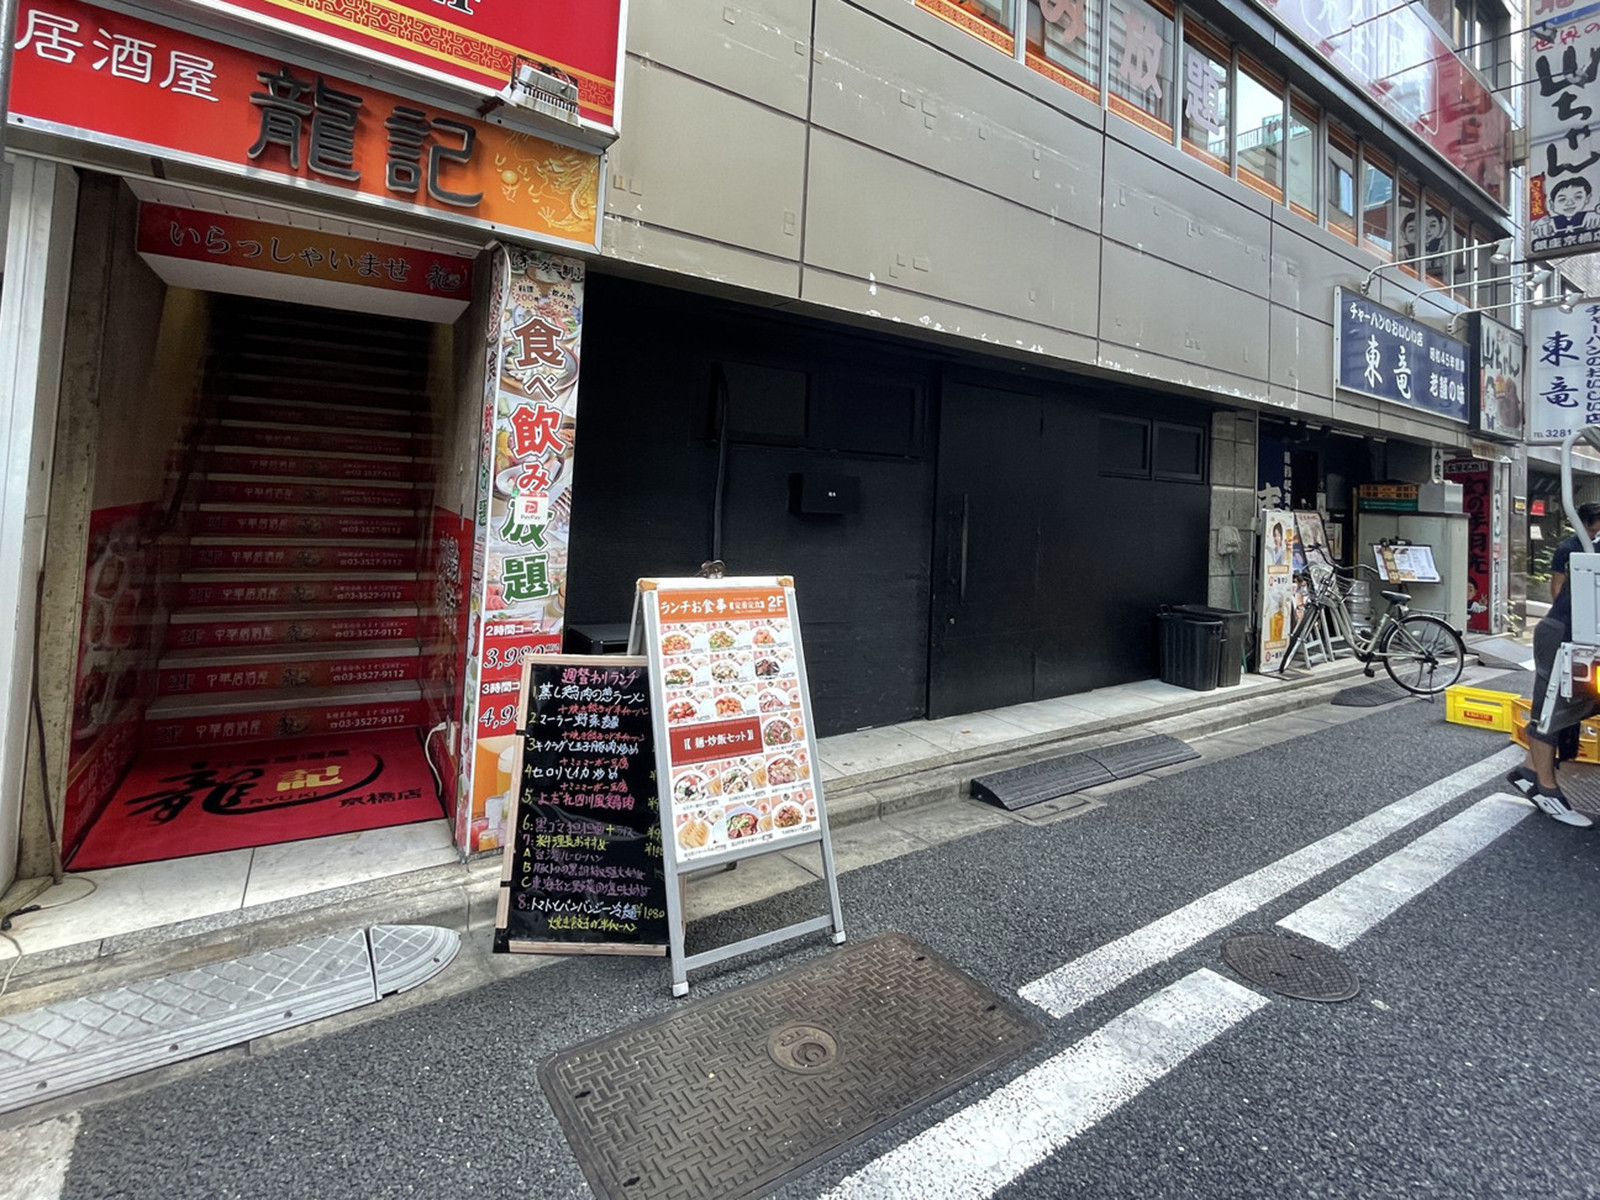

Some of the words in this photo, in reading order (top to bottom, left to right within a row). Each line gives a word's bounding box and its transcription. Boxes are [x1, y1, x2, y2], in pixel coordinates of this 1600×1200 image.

[14, 9, 219, 103] 居酒屋
[247, 66, 484, 207] 龍記
[169, 221, 411, 283] いらっしゃいませ
[1364, 333, 1412, 400] 東竜
[1539, 330, 1580, 409] 東竜
[767, 595, 784, 608] 2F
[340, 628, 404, 639] 03-3527-9112
[485, 623, 543, 637] 2時間コース
[340, 669, 405, 682] 03-3527-9112
[337, 715, 406, 729] 03-3527-9112
[338, 787, 423, 808] 京橋店
[523, 848, 532, 858] A
[522, 861, 532, 873] B
[521, 876, 532, 888] C
